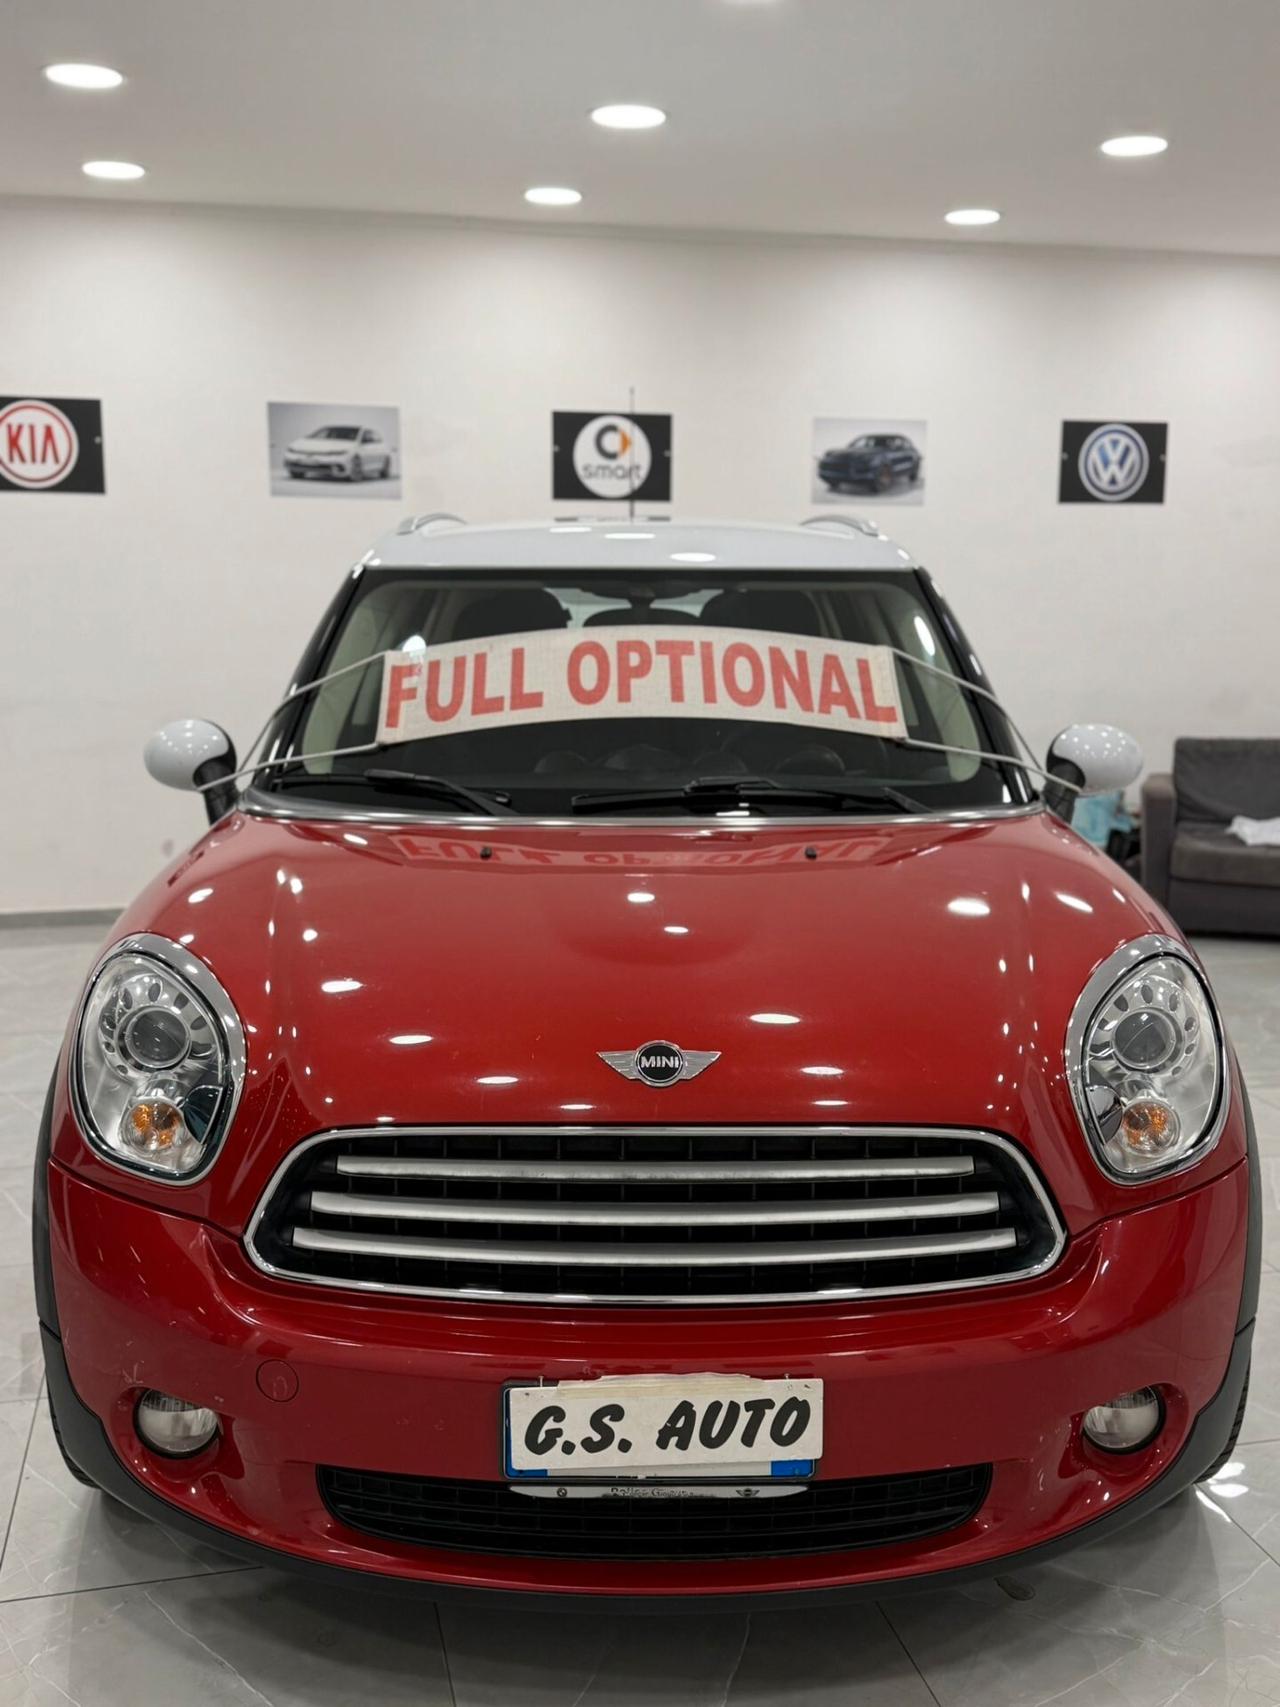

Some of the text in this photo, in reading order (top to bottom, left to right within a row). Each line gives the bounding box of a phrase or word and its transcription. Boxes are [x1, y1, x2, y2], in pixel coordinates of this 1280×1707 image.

[7, 424, 60, 464] KIA
[582, 463, 642, 479] smart
[385, 640, 897, 728] FULL OPTIONAL
[641, 1056, 679, 1068] MINI
[524, 1397, 811, 1456] G.S. AUTO
